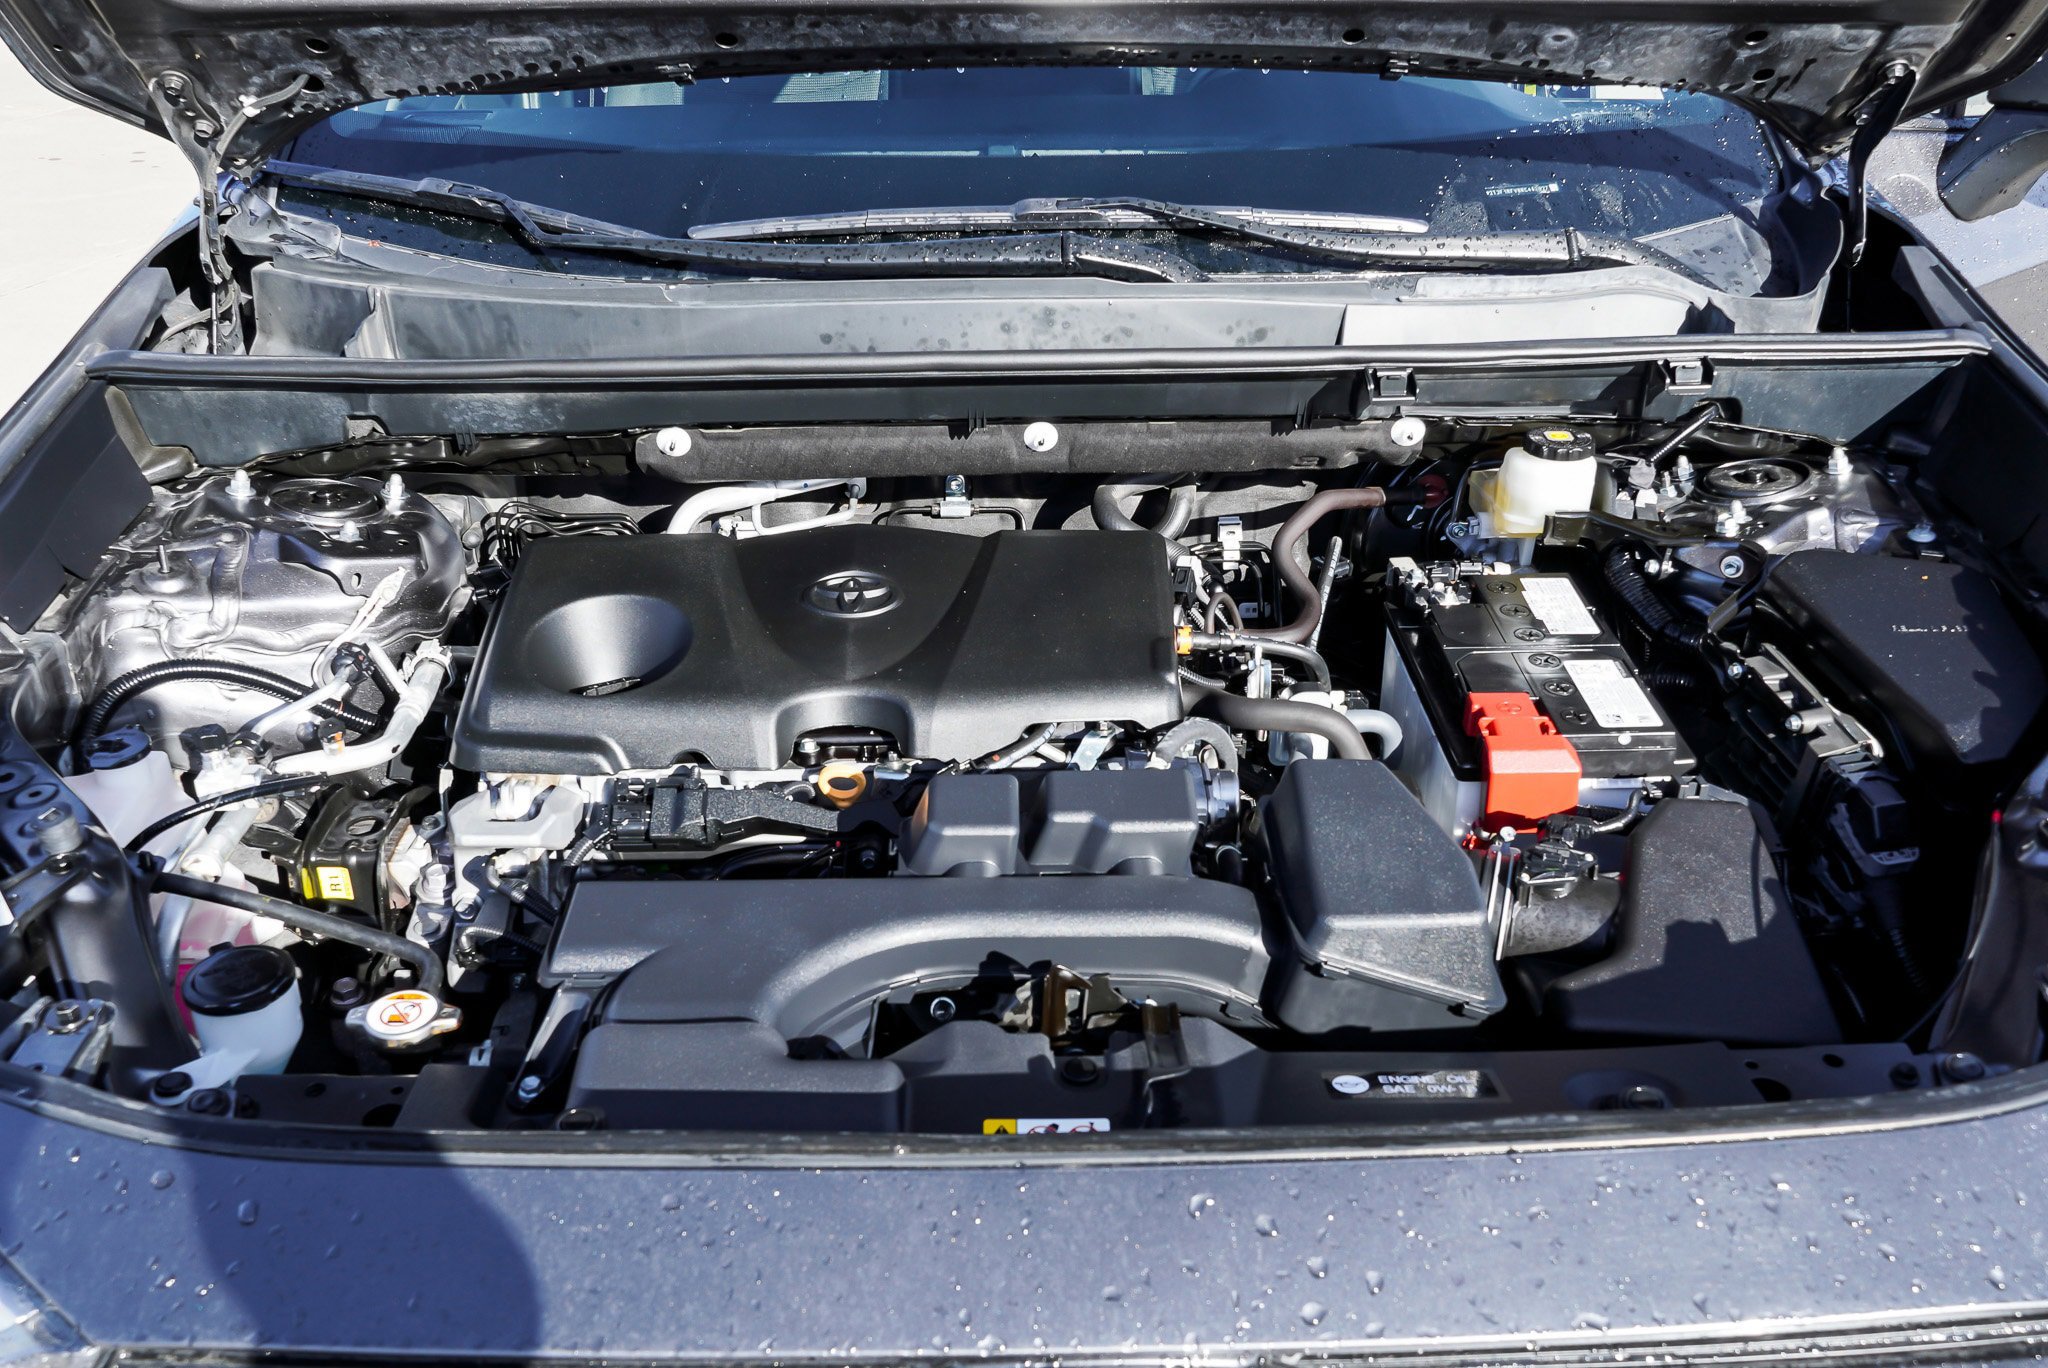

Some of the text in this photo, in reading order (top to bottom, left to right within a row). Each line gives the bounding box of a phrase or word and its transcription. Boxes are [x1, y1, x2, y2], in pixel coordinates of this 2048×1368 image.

[1377, 1075, 1476, 1084] ENGINE OIL
[1382, 1085, 1416, 1094] SAE
